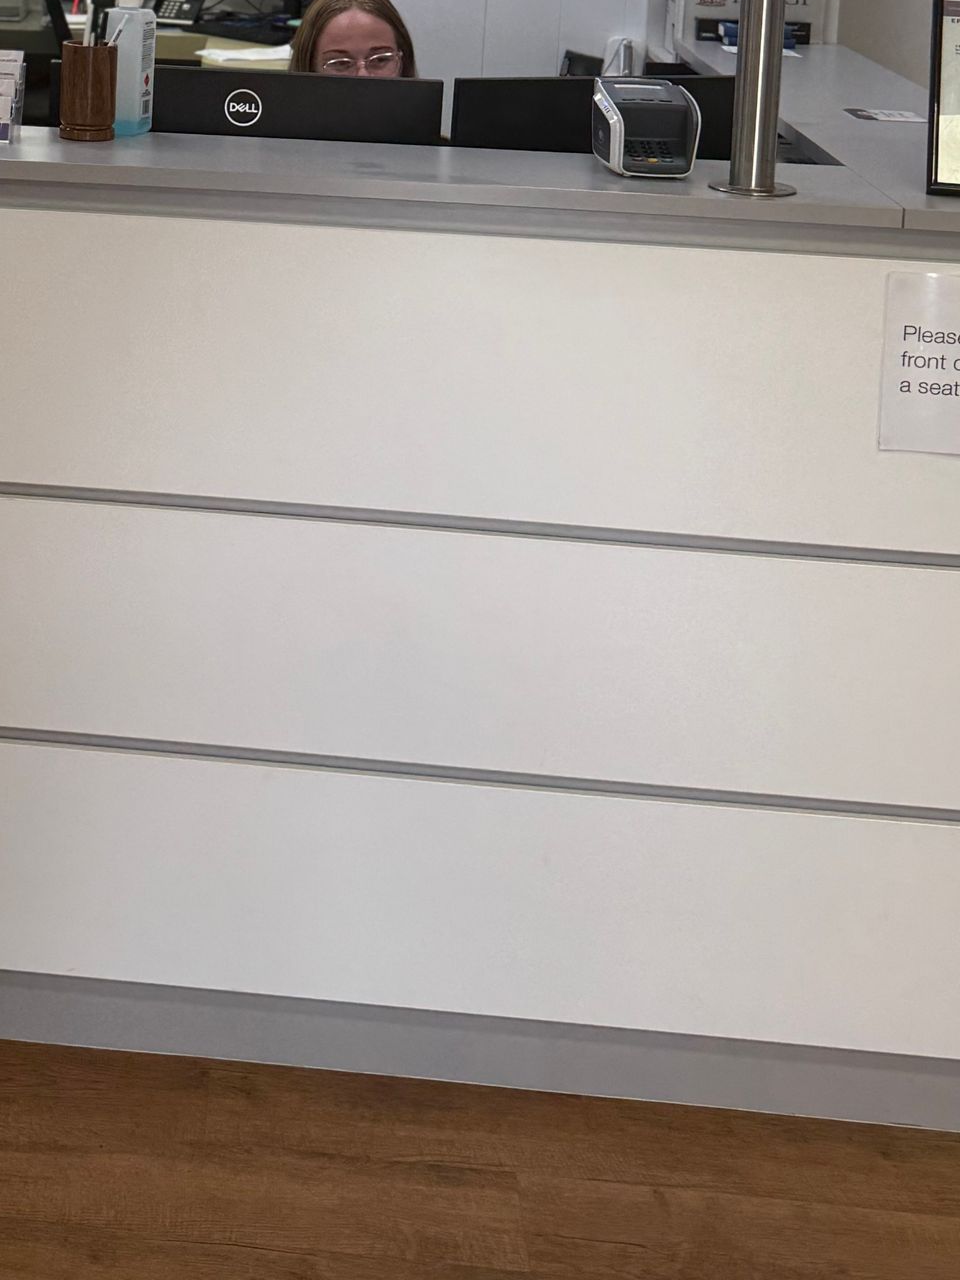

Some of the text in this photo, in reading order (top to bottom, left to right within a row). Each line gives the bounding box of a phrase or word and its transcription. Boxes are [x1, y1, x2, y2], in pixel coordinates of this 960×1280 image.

[229, 102, 258, 113] DELL
[900, 350, 947, 370] front
[899, 380, 960, 396] a seat
